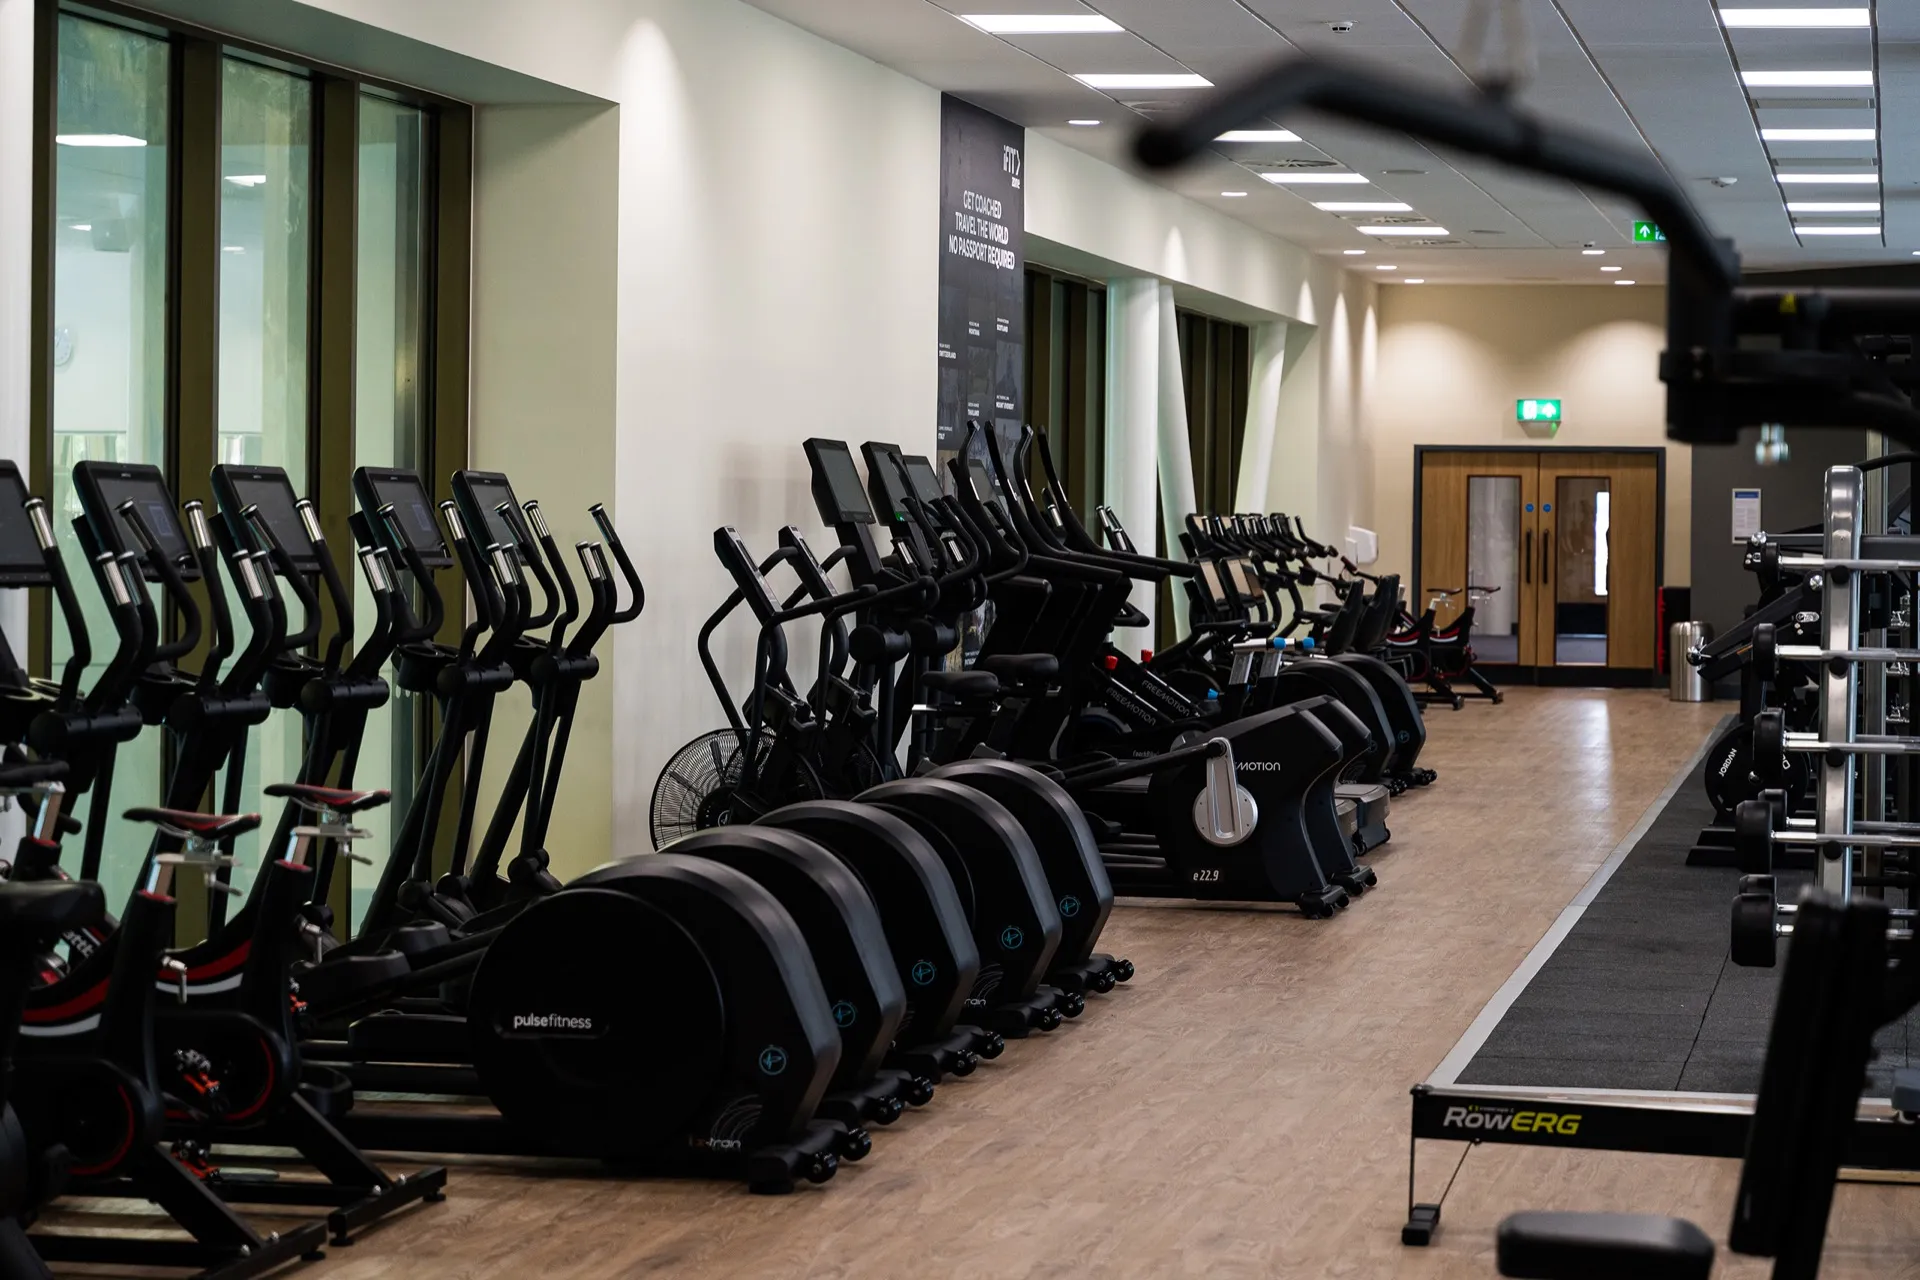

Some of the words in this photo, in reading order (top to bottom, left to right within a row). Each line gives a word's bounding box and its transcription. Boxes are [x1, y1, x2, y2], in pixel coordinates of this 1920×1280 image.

[963, 189, 975, 210] GET
[975, 194, 1002, 219] COACHED
[955, 211, 977, 236] TRAVEL
[977, 217, 988, 239] THE
[988, 221, 1009, 245] WORLD
[948, 234, 958, 255] NO
[958, 236, 987, 262] PASSPORT
[987, 245, 1015, 270] REQUIRED
[1105, 687, 1157, 726] FREEMOTION
[1141, 679, 1190, 717] FREEMOTION
[1719, 748, 1738, 777] JORDAN
[513, 1012, 592, 1030] pulsefitness
